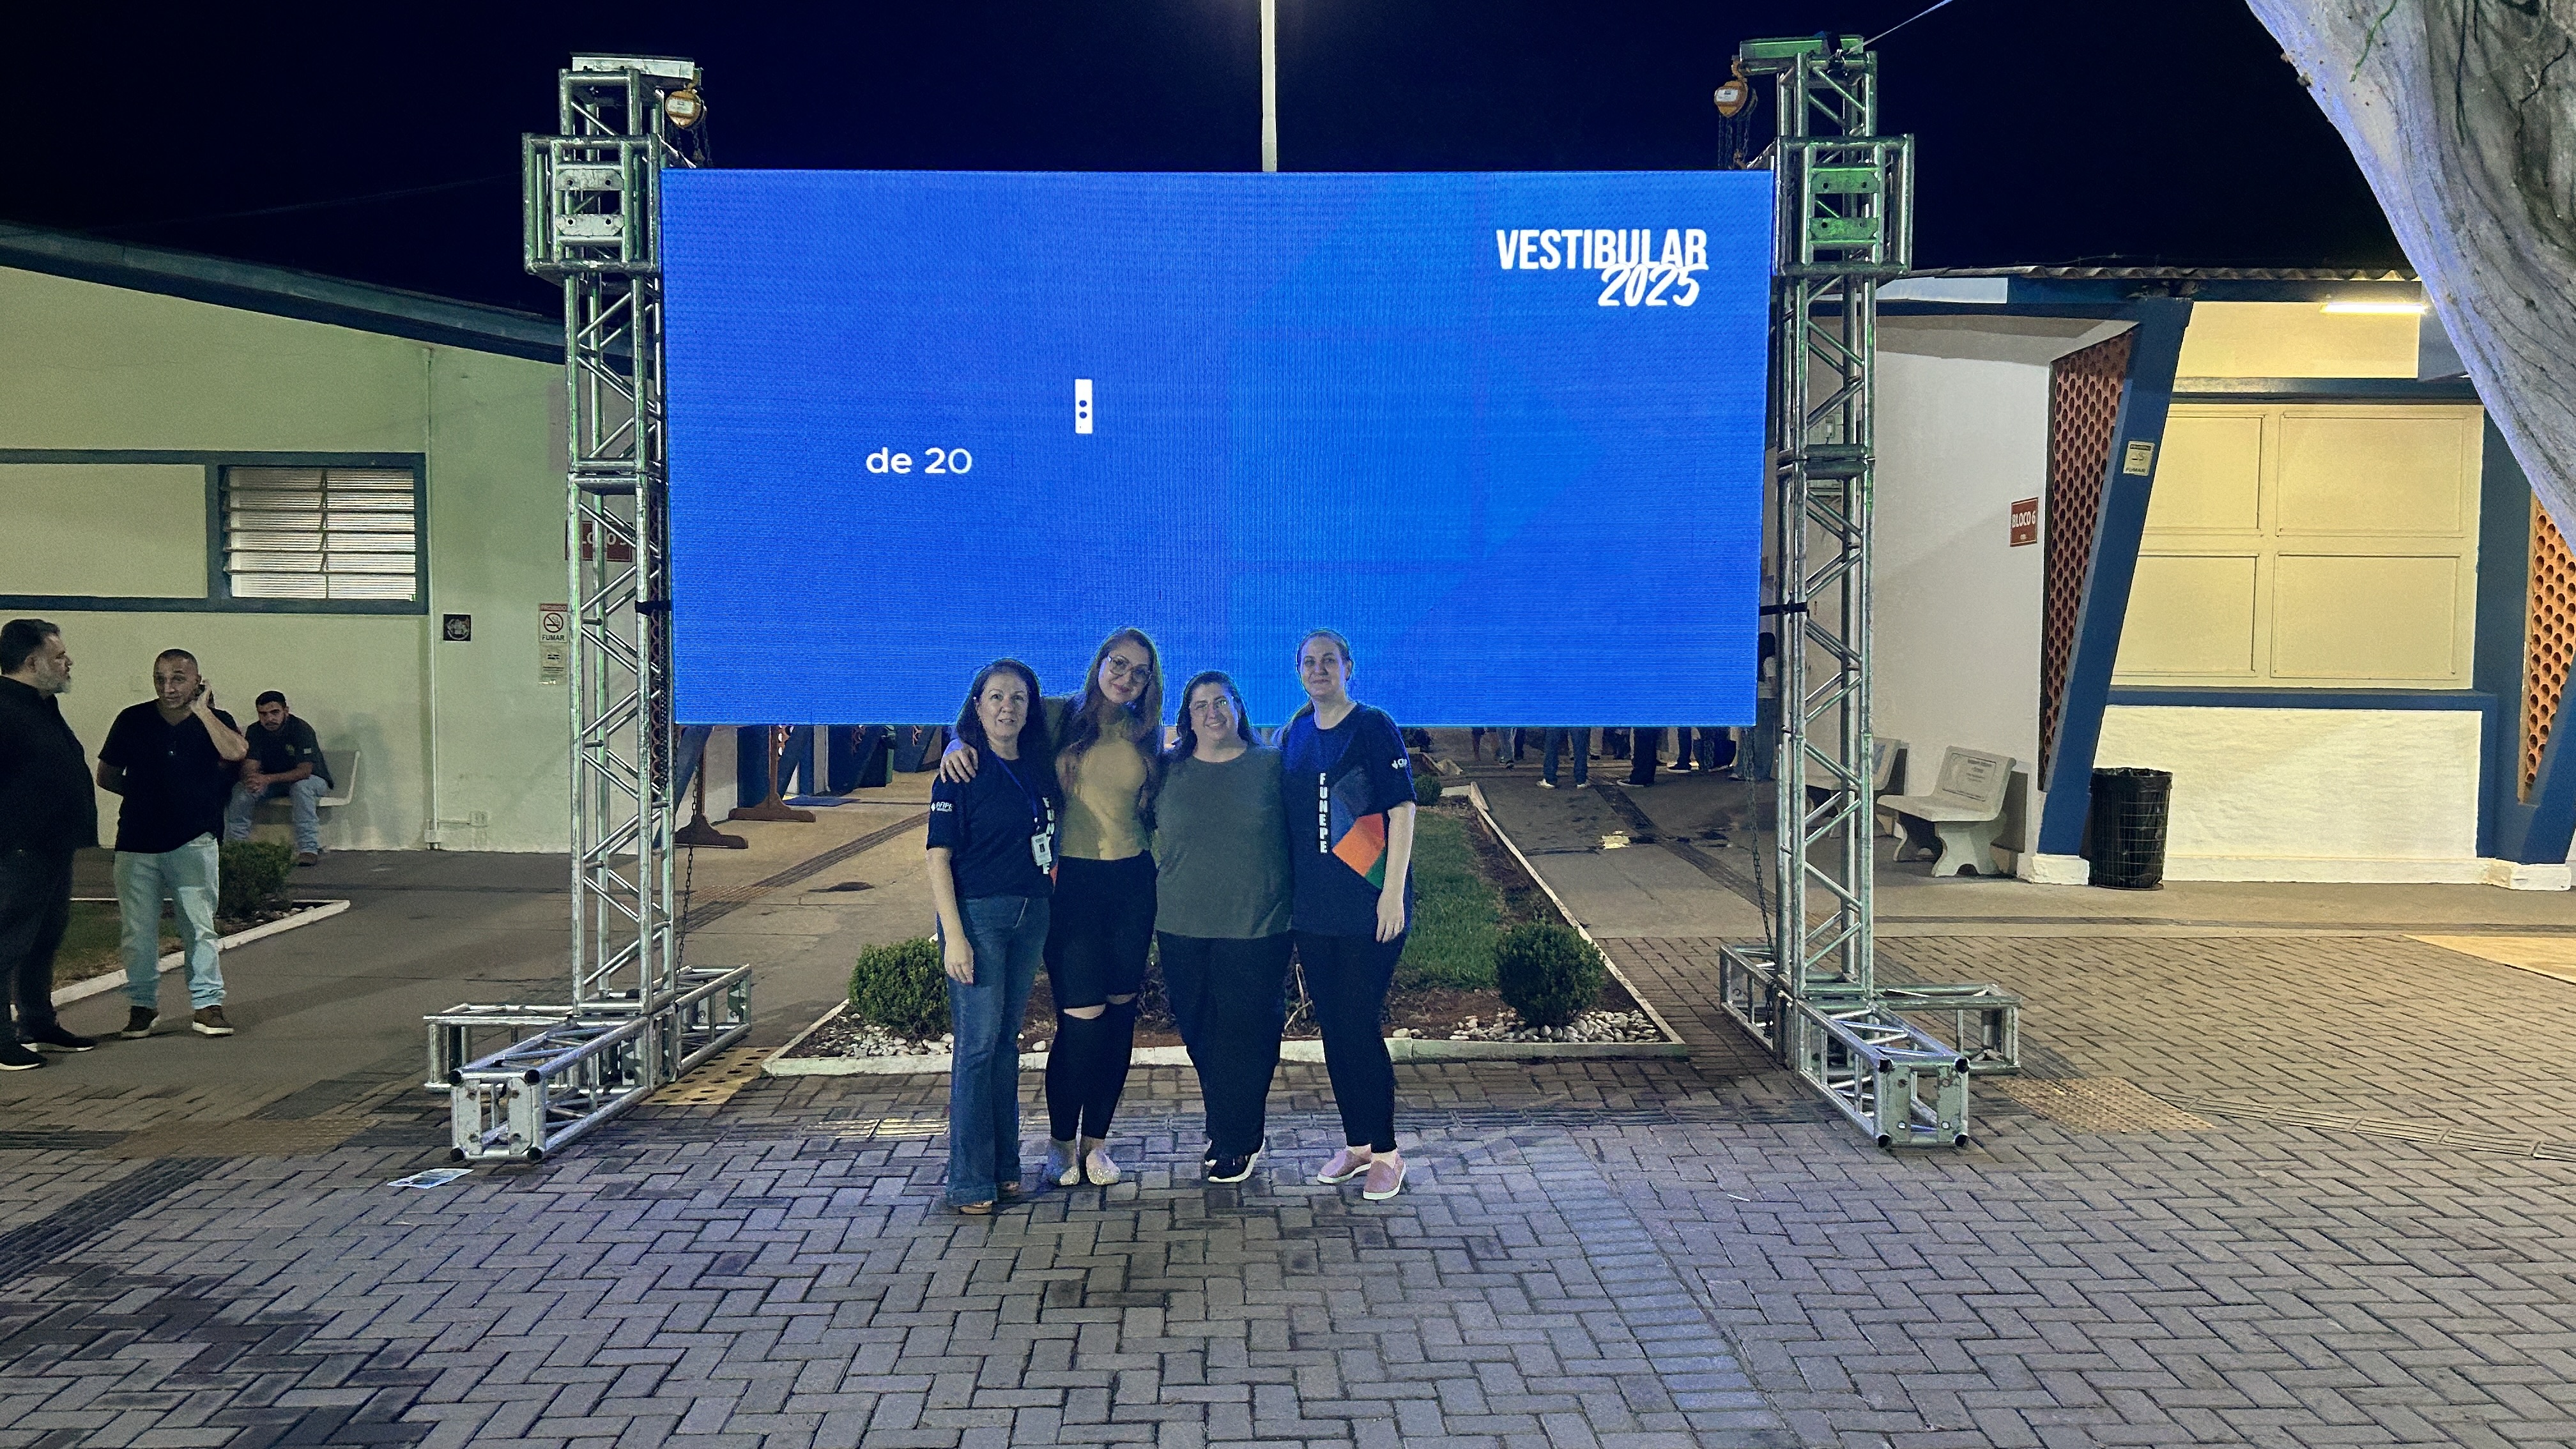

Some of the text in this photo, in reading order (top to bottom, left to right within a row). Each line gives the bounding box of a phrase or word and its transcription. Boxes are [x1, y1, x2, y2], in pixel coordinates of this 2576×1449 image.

[1496, 229, 1707, 270] VESTIBULAR
[1598, 263, 1709, 307] 2025
[866, 447, 972, 474] de 20
[2012, 510, 2036, 528] BLOCO 6
[1319, 772, 1328, 853] FUNEPE
